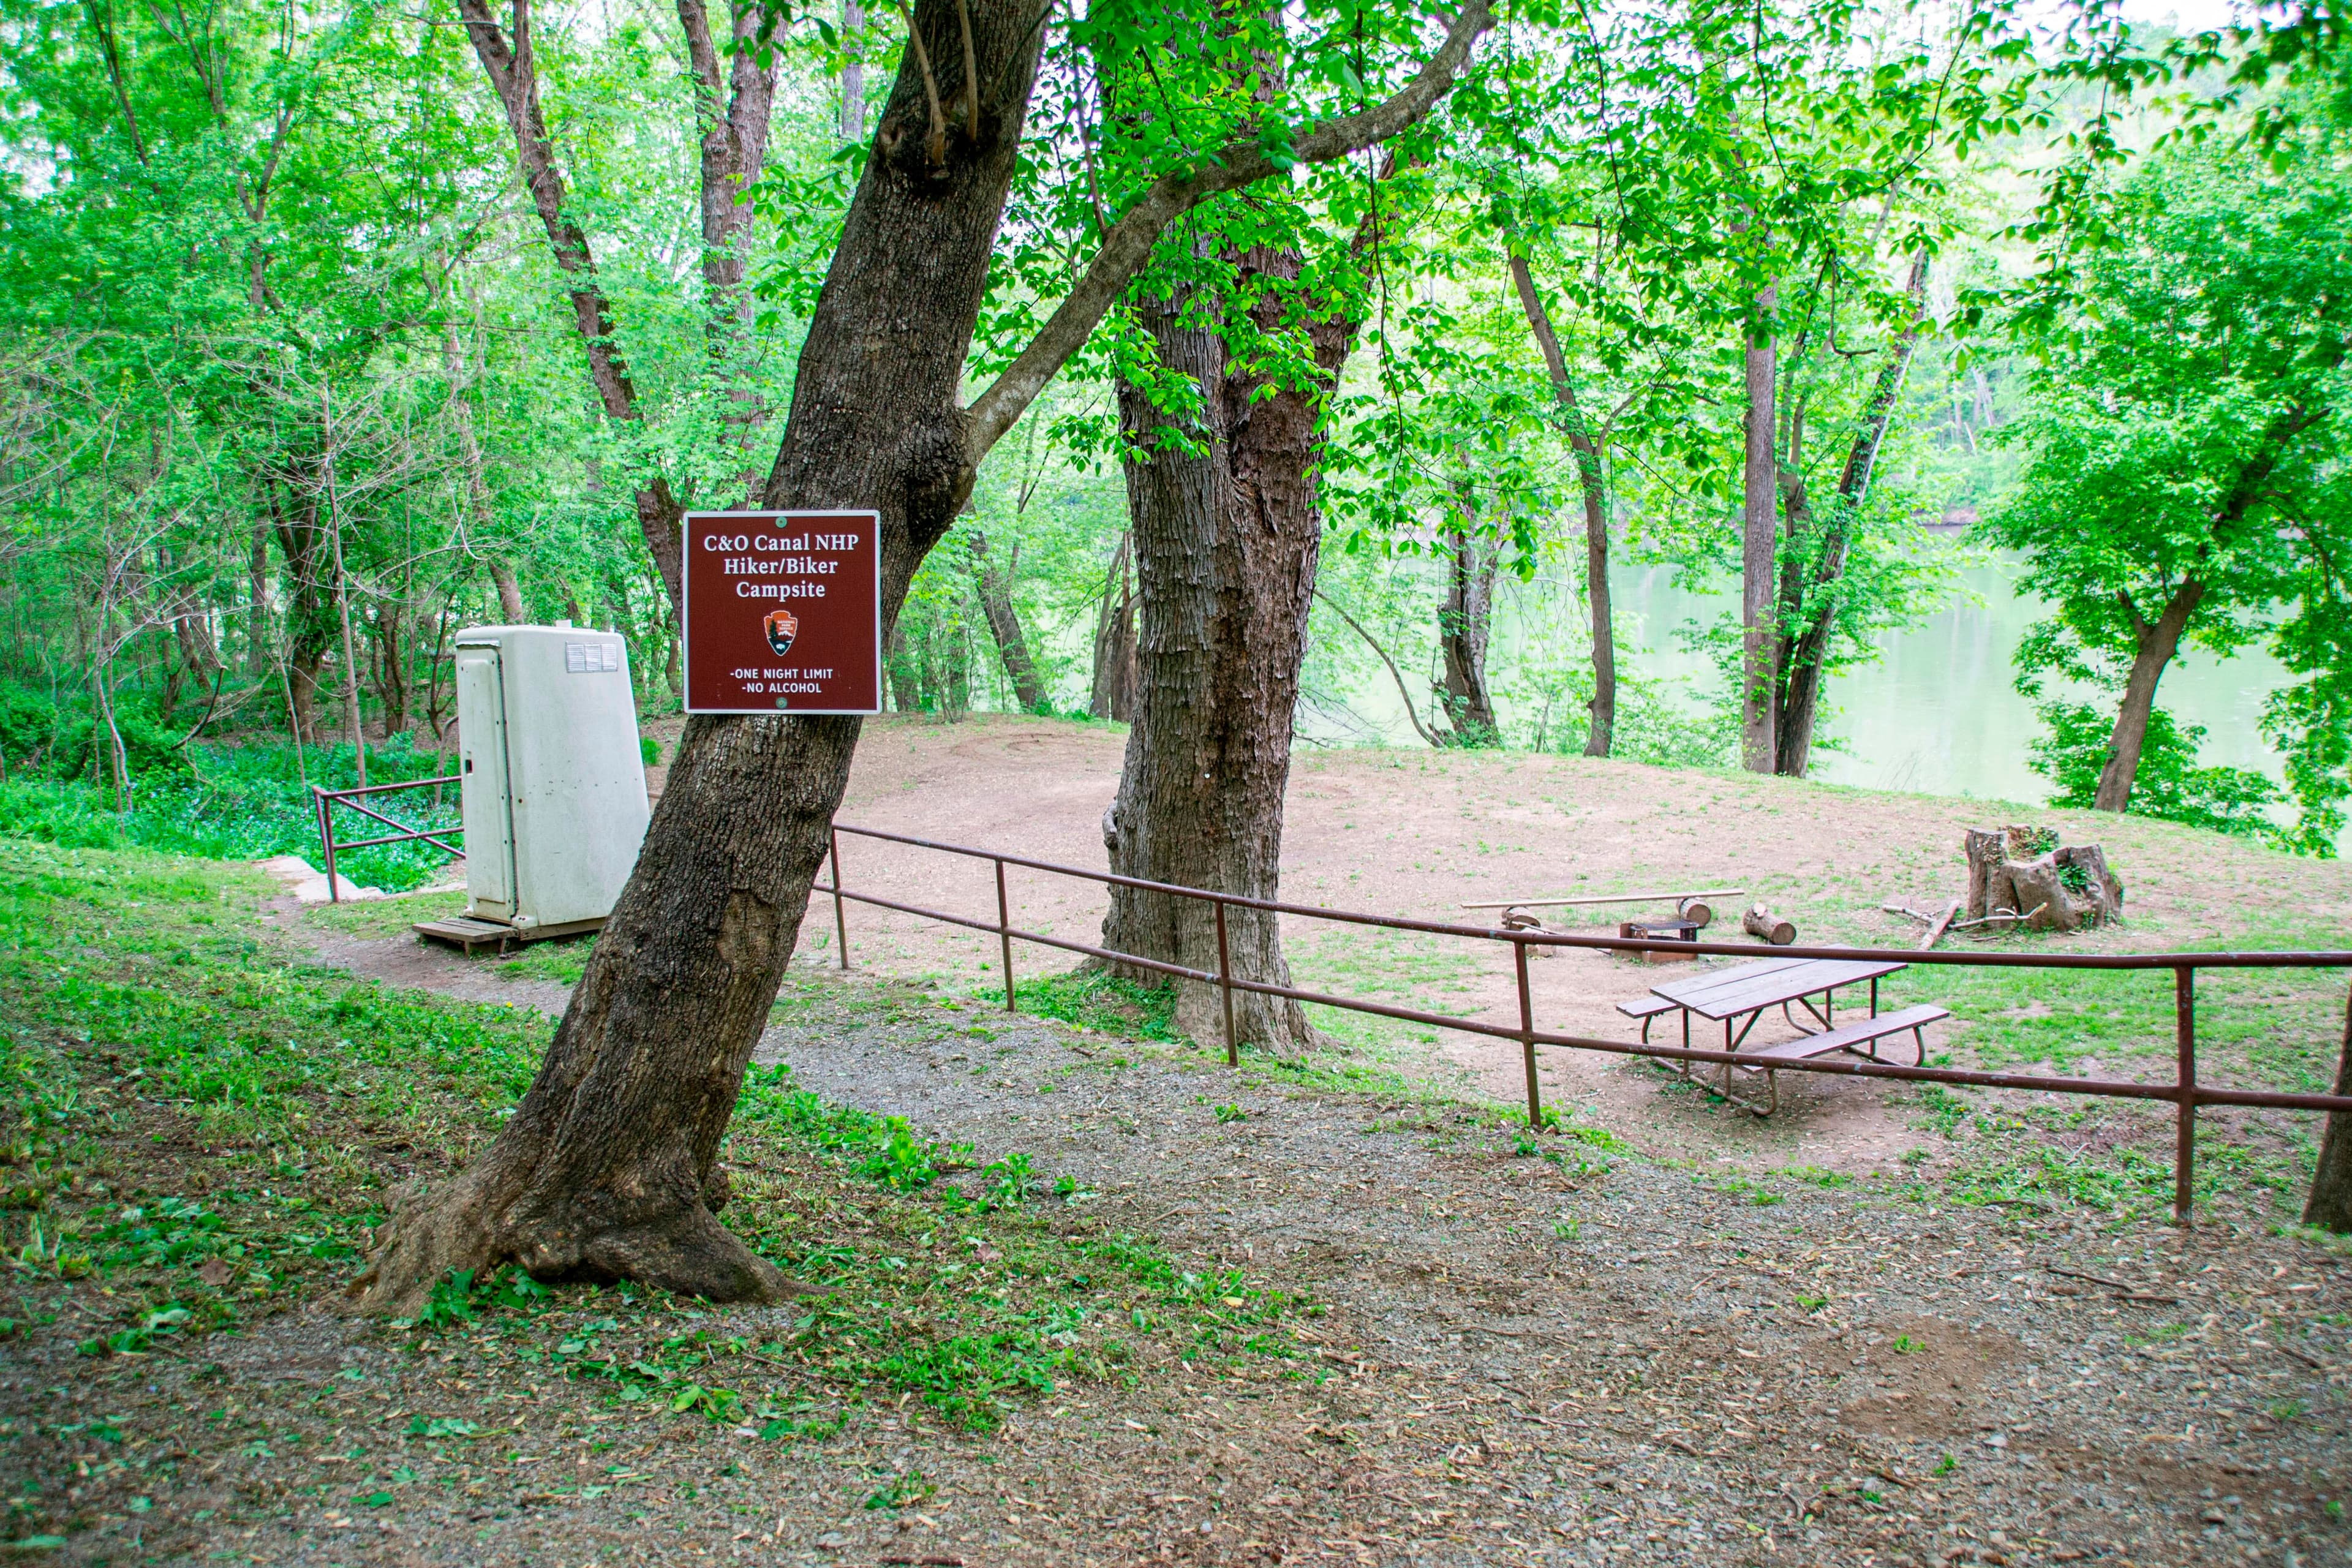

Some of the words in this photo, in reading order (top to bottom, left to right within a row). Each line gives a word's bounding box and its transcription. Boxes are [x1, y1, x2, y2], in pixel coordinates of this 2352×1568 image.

[704, 535, 748, 551] C&O
[754, 533, 810, 551] Canal
[815, 535, 859, 550] NHP
[724, 557, 839, 574] Hiker/Biker
[736, 580, 825, 602] Campsite
[730, 669, 758, 679] -ONE
[764, 669, 799, 679] NIGHT
[804, 669, 833, 679] LIMIT
[742, 683, 764, 693] -NO
[769, 683, 822, 693] ALCOHOL
